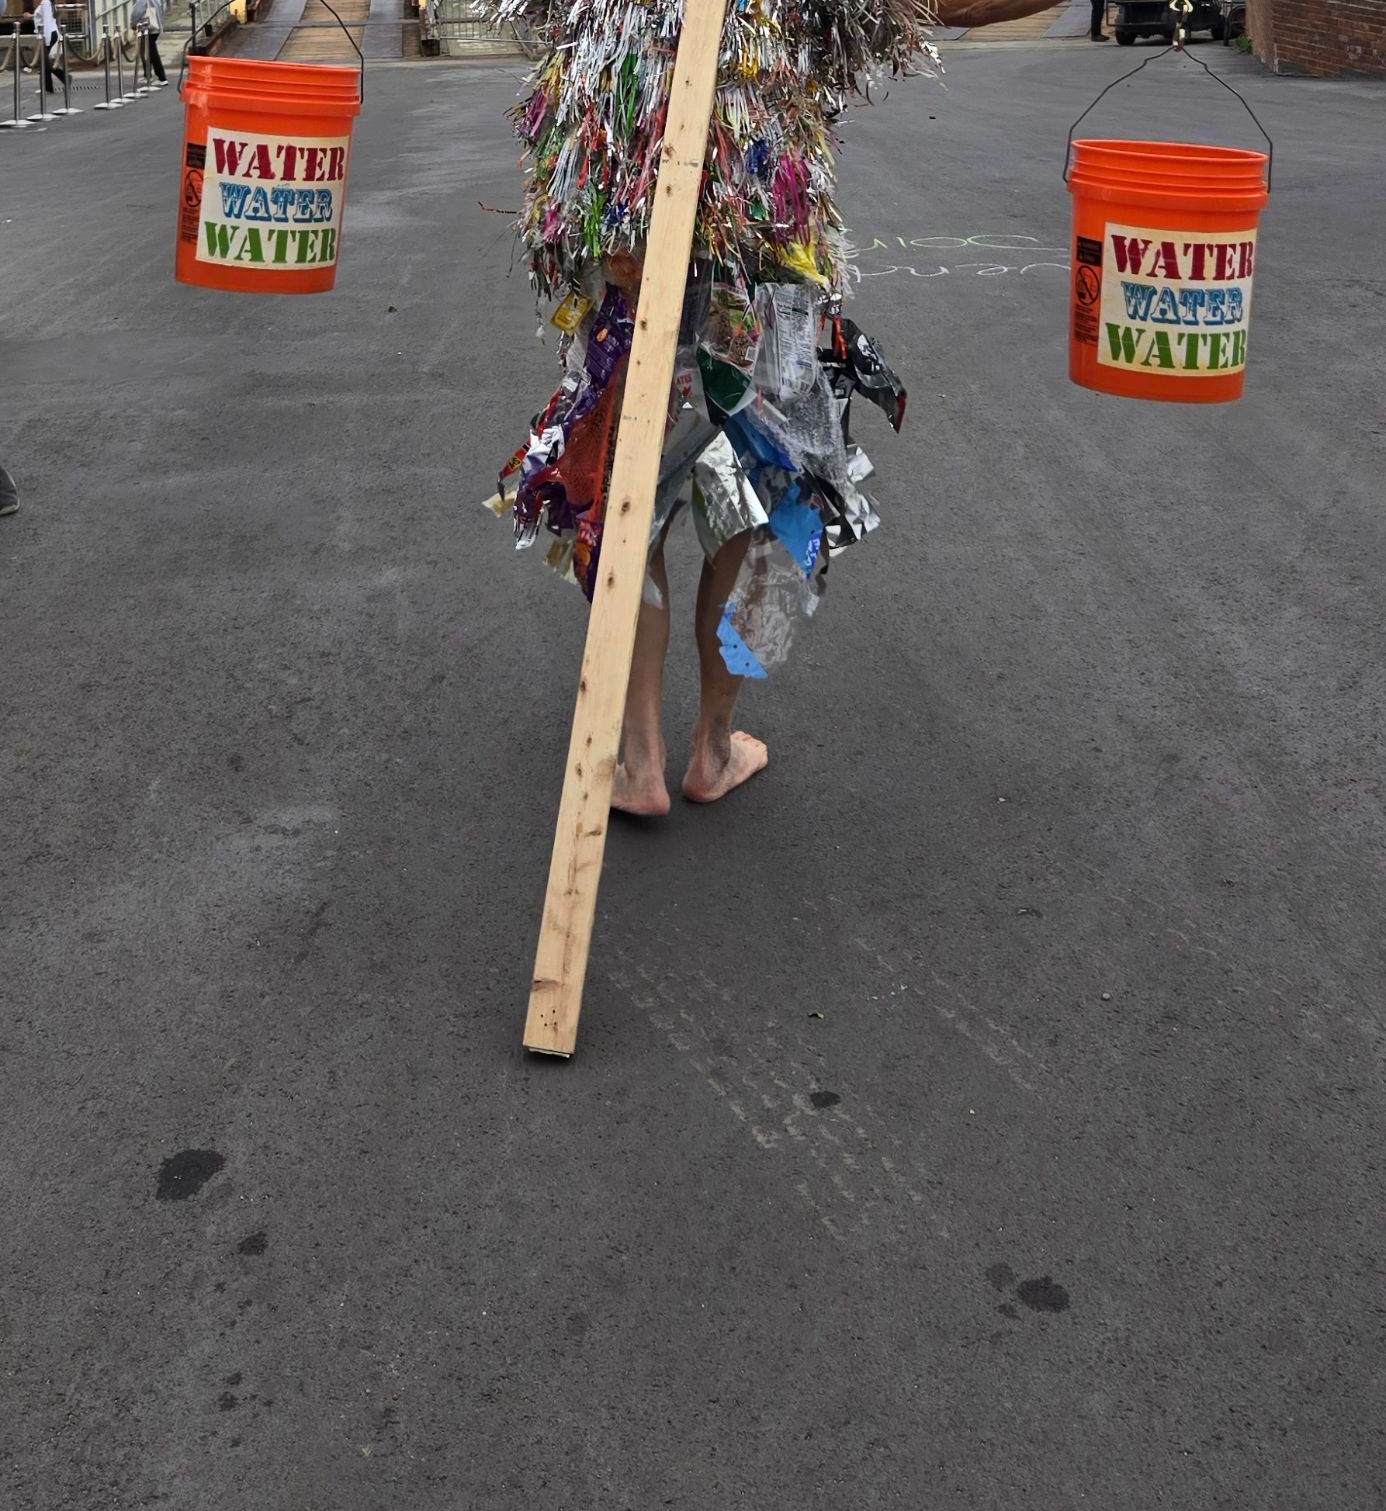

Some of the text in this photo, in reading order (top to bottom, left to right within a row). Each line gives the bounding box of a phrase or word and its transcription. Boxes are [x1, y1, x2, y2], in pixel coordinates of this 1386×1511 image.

[213, 137, 345, 182] WATER
[219, 181, 333, 223] WATER
[204, 221, 337, 265] WATER
[1111, 234, 1255, 281] WATER
[1121, 280, 1243, 326] WATER
[1105, 322, 1247, 370] WATER
